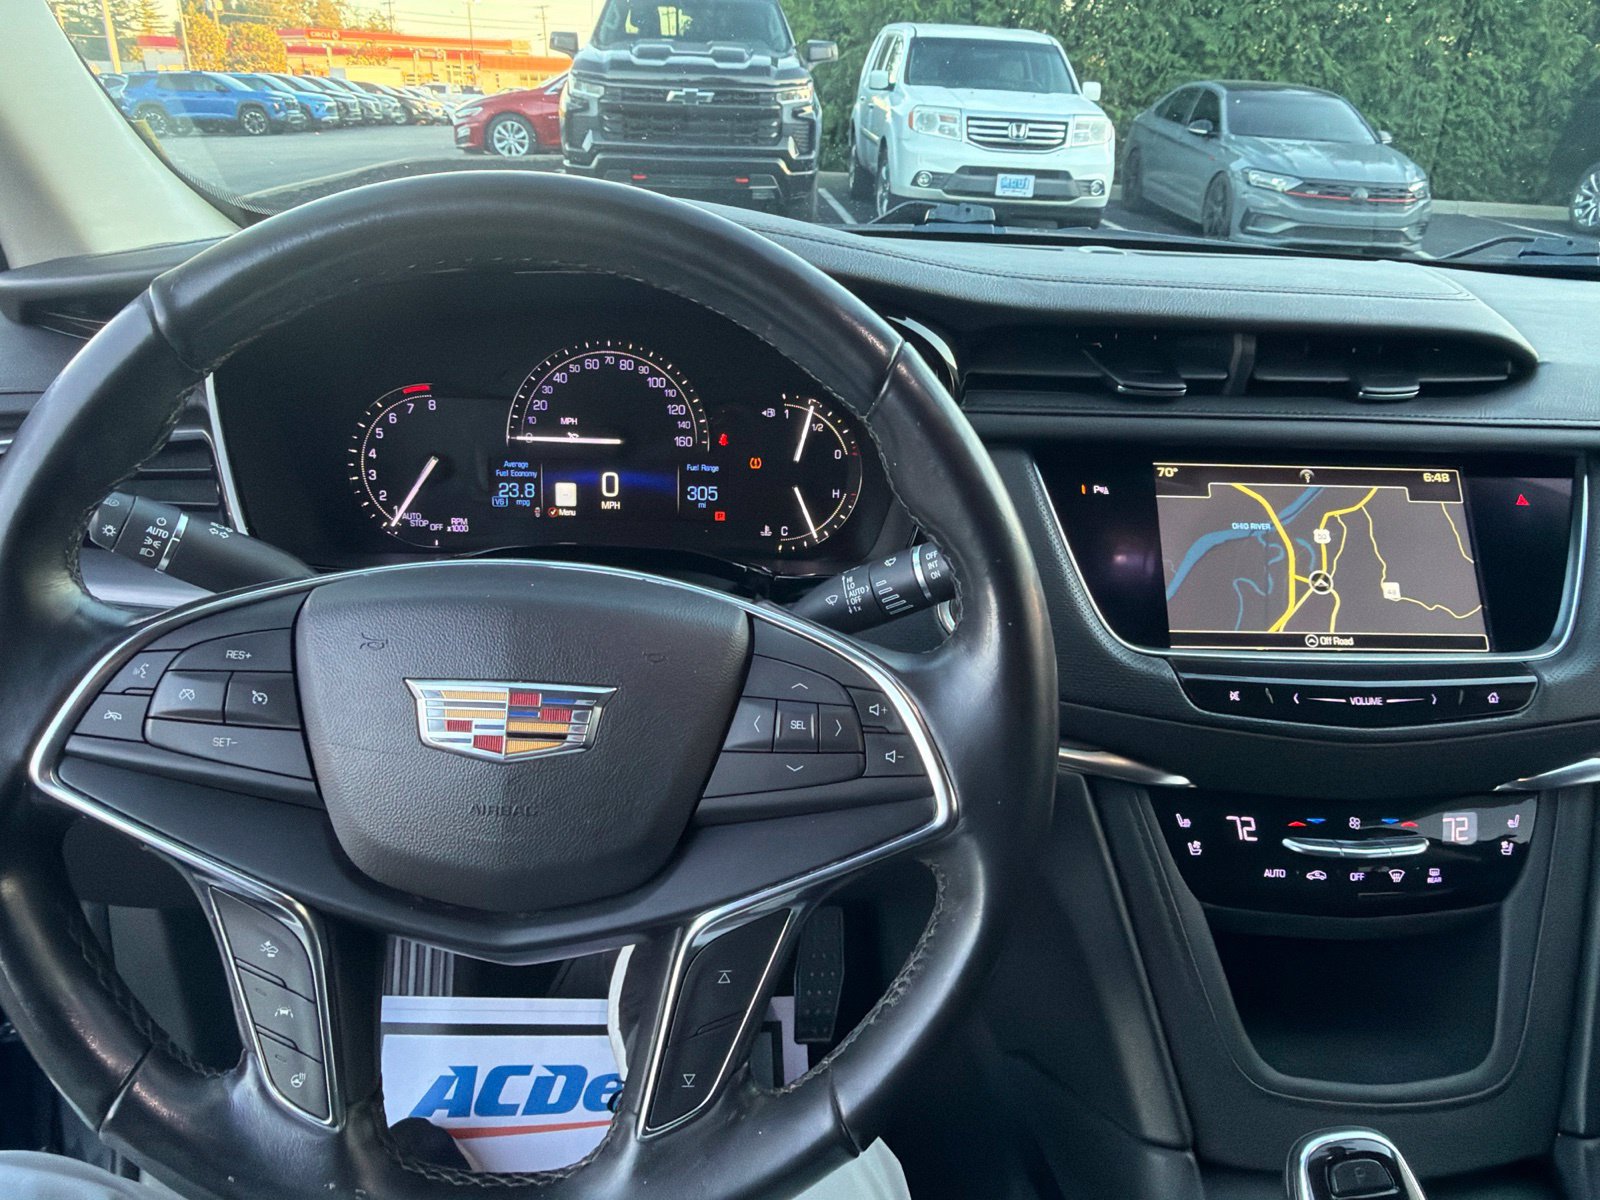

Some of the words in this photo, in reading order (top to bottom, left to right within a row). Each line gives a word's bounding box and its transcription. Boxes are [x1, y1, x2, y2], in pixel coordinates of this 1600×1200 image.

[585, 359, 600, 370] 60
[604, 356, 615, 365] 70
[619, 360, 634, 371] 80
[569, 364, 581, 373] 50
[638, 365, 650, 375] 90
[553, 373, 568, 384] 40
[646, 377, 666, 388] 100
[542, 385, 554, 394] 30
[664, 389, 677, 397] 110
[407, 403, 415, 414] 7
[428, 400, 437, 410] 8
[533, 400, 547, 411] 20
[667, 404, 686, 415] 120
[388, 413, 397, 424] 6
[527, 416, 537, 425] 10
[560, 417, 578, 425] MPH
[677, 421, 691, 429] 140
[812, 423, 824, 432] 1/2
[375, 428, 384, 439] 5
[674, 436, 693, 447] 160
[368, 448, 377, 459] 4
[503, 461, 529, 469] Average
[700, 464, 720, 472] Range
[368, 470, 377, 481] 3
[510, 470, 537, 478] Economy
[1423, 473, 1450, 482] 6:48
[601, 471, 619, 497] 0
[498, 482, 535, 498] 23.8
[687, 486, 718, 501] 305
[831, 489, 840, 499] H
[379, 490, 388, 501] 2
[601, 501, 621, 510] MPH
[402, 512, 422, 520] AUTO
[430, 523, 443, 531] OFF
[780, 526, 788, 536] C
[146, 526, 169, 539] AUTO
[925, 550, 938, 560] OFF
[927, 560, 938, 570] INT
[930, 570, 940, 580] ON
[847, 582, 855, 590] LO
[848, 588, 865, 597] AUTO
[850, 596, 862, 605] OFF
[1320, 636, 1332, 645] Off
[1333, 636, 1354, 646] Road
[226, 650, 252, 660] RES+
[1350, 696, 1383, 706] VOLUME
[790, 720, 806, 730] SEL
[1226, 816, 1258, 841] 72
[1442, 817, 1468, 841] 72
[1264, 869, 1286, 878] AUTO
[1350, 872, 1365, 881] OFF
